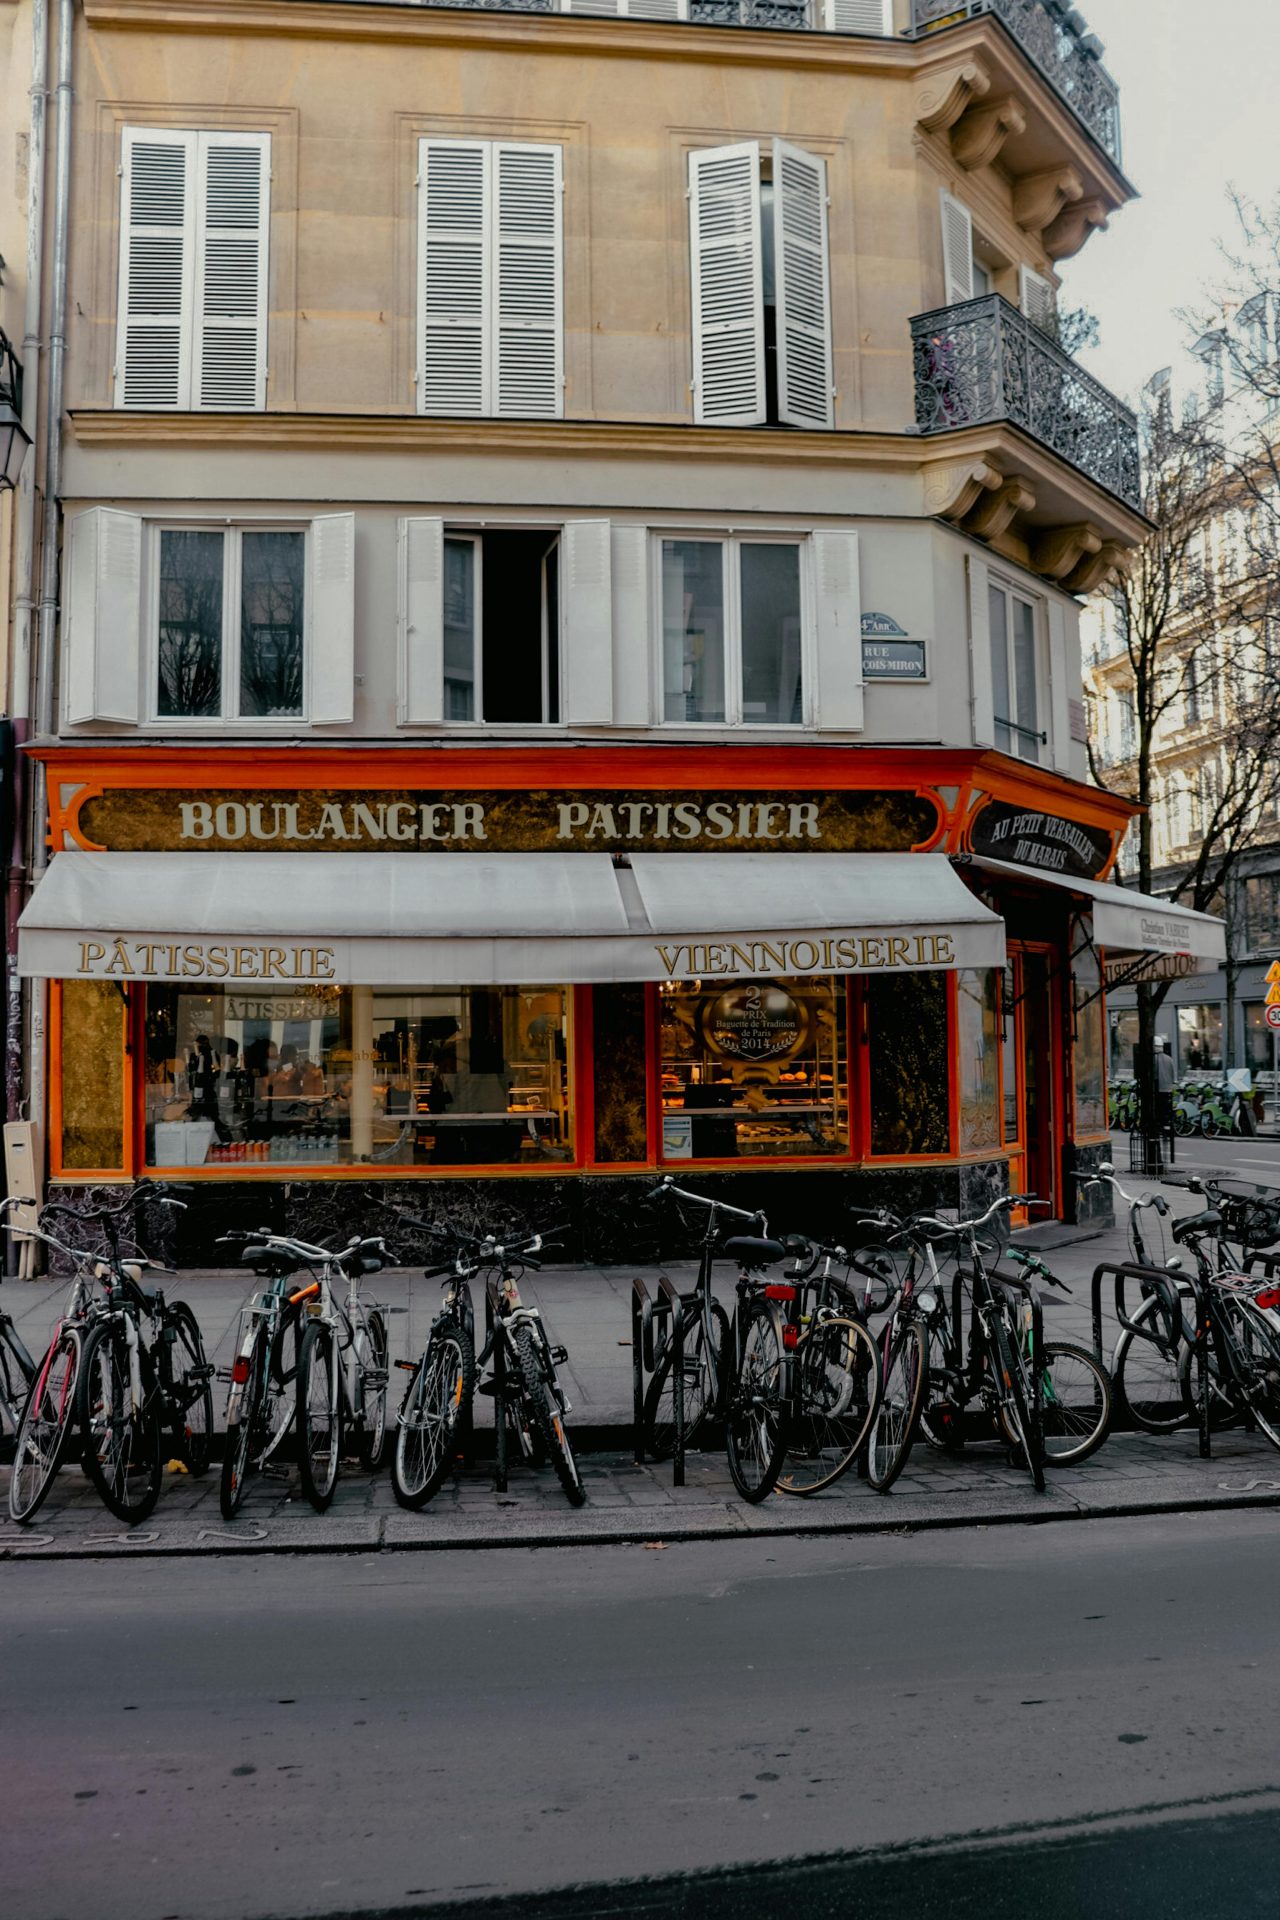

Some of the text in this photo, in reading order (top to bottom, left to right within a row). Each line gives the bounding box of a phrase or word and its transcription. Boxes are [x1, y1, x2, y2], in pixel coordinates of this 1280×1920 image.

[864, 647, 889, 657] RUE
[179, 801, 488, 841] BOULANGER
[556, 801, 822, 840] PATISSIER
[990, 814, 1096, 865] AU PETIT VERSAILLES
[1013, 839, 1068, 869] DU MARAIS
[77, 936, 335, 978] PÂTISSERIE
[654, 933, 956, 976] VIENNOISERIE
[716, 1020, 796, 1029] Baguette de Tradition
[743, 1010, 767, 1019] PRIX
[741, 1029, 772, 1037] de Paris
[741, 1038, 771, 1049] 2014
